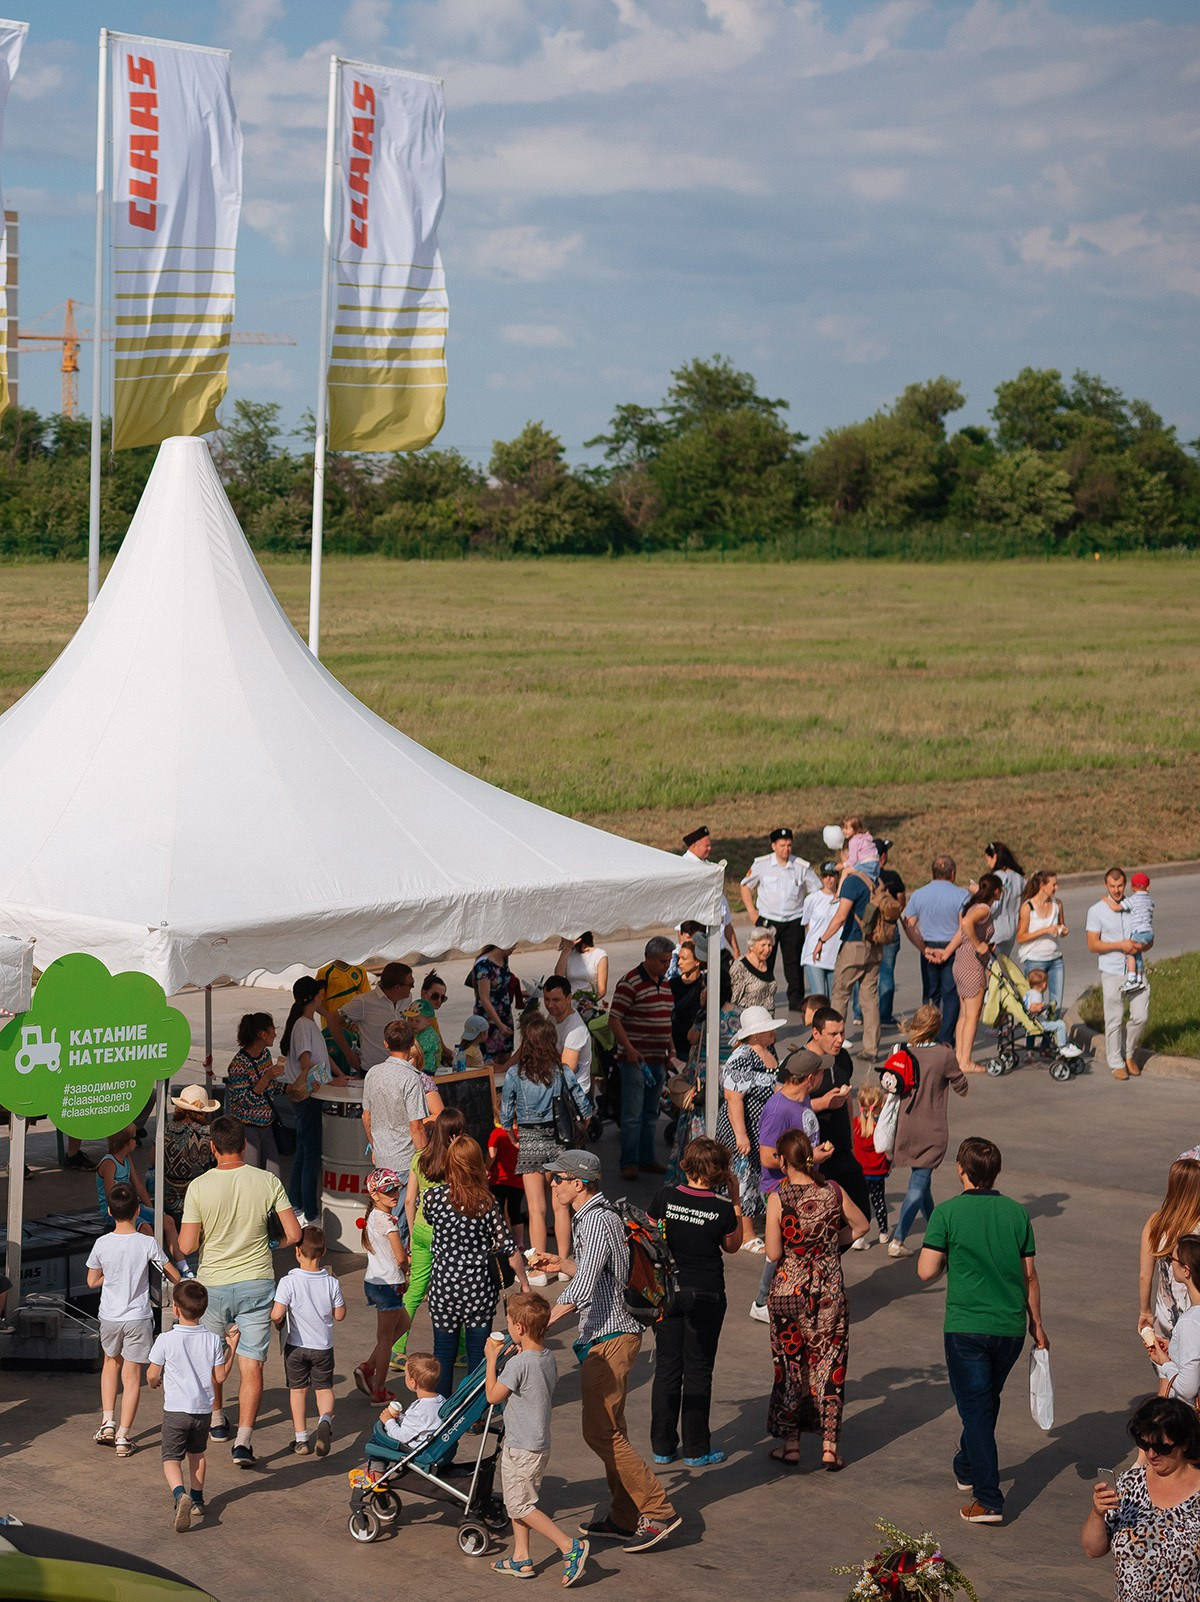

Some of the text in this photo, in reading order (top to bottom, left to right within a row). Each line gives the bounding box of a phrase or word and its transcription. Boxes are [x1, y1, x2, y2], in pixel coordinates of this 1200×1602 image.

[127, 54, 159, 231] CLAAS
[349, 79, 375, 249] CLAAS
[69, 1024, 147, 1045] КАТАНИЕ
[64, 1079, 136, 1094] #заводимлето
[61, 1102, 130, 1118] #claaskrasnoda
[667, 1203, 719, 1220] изнес-тариф?
